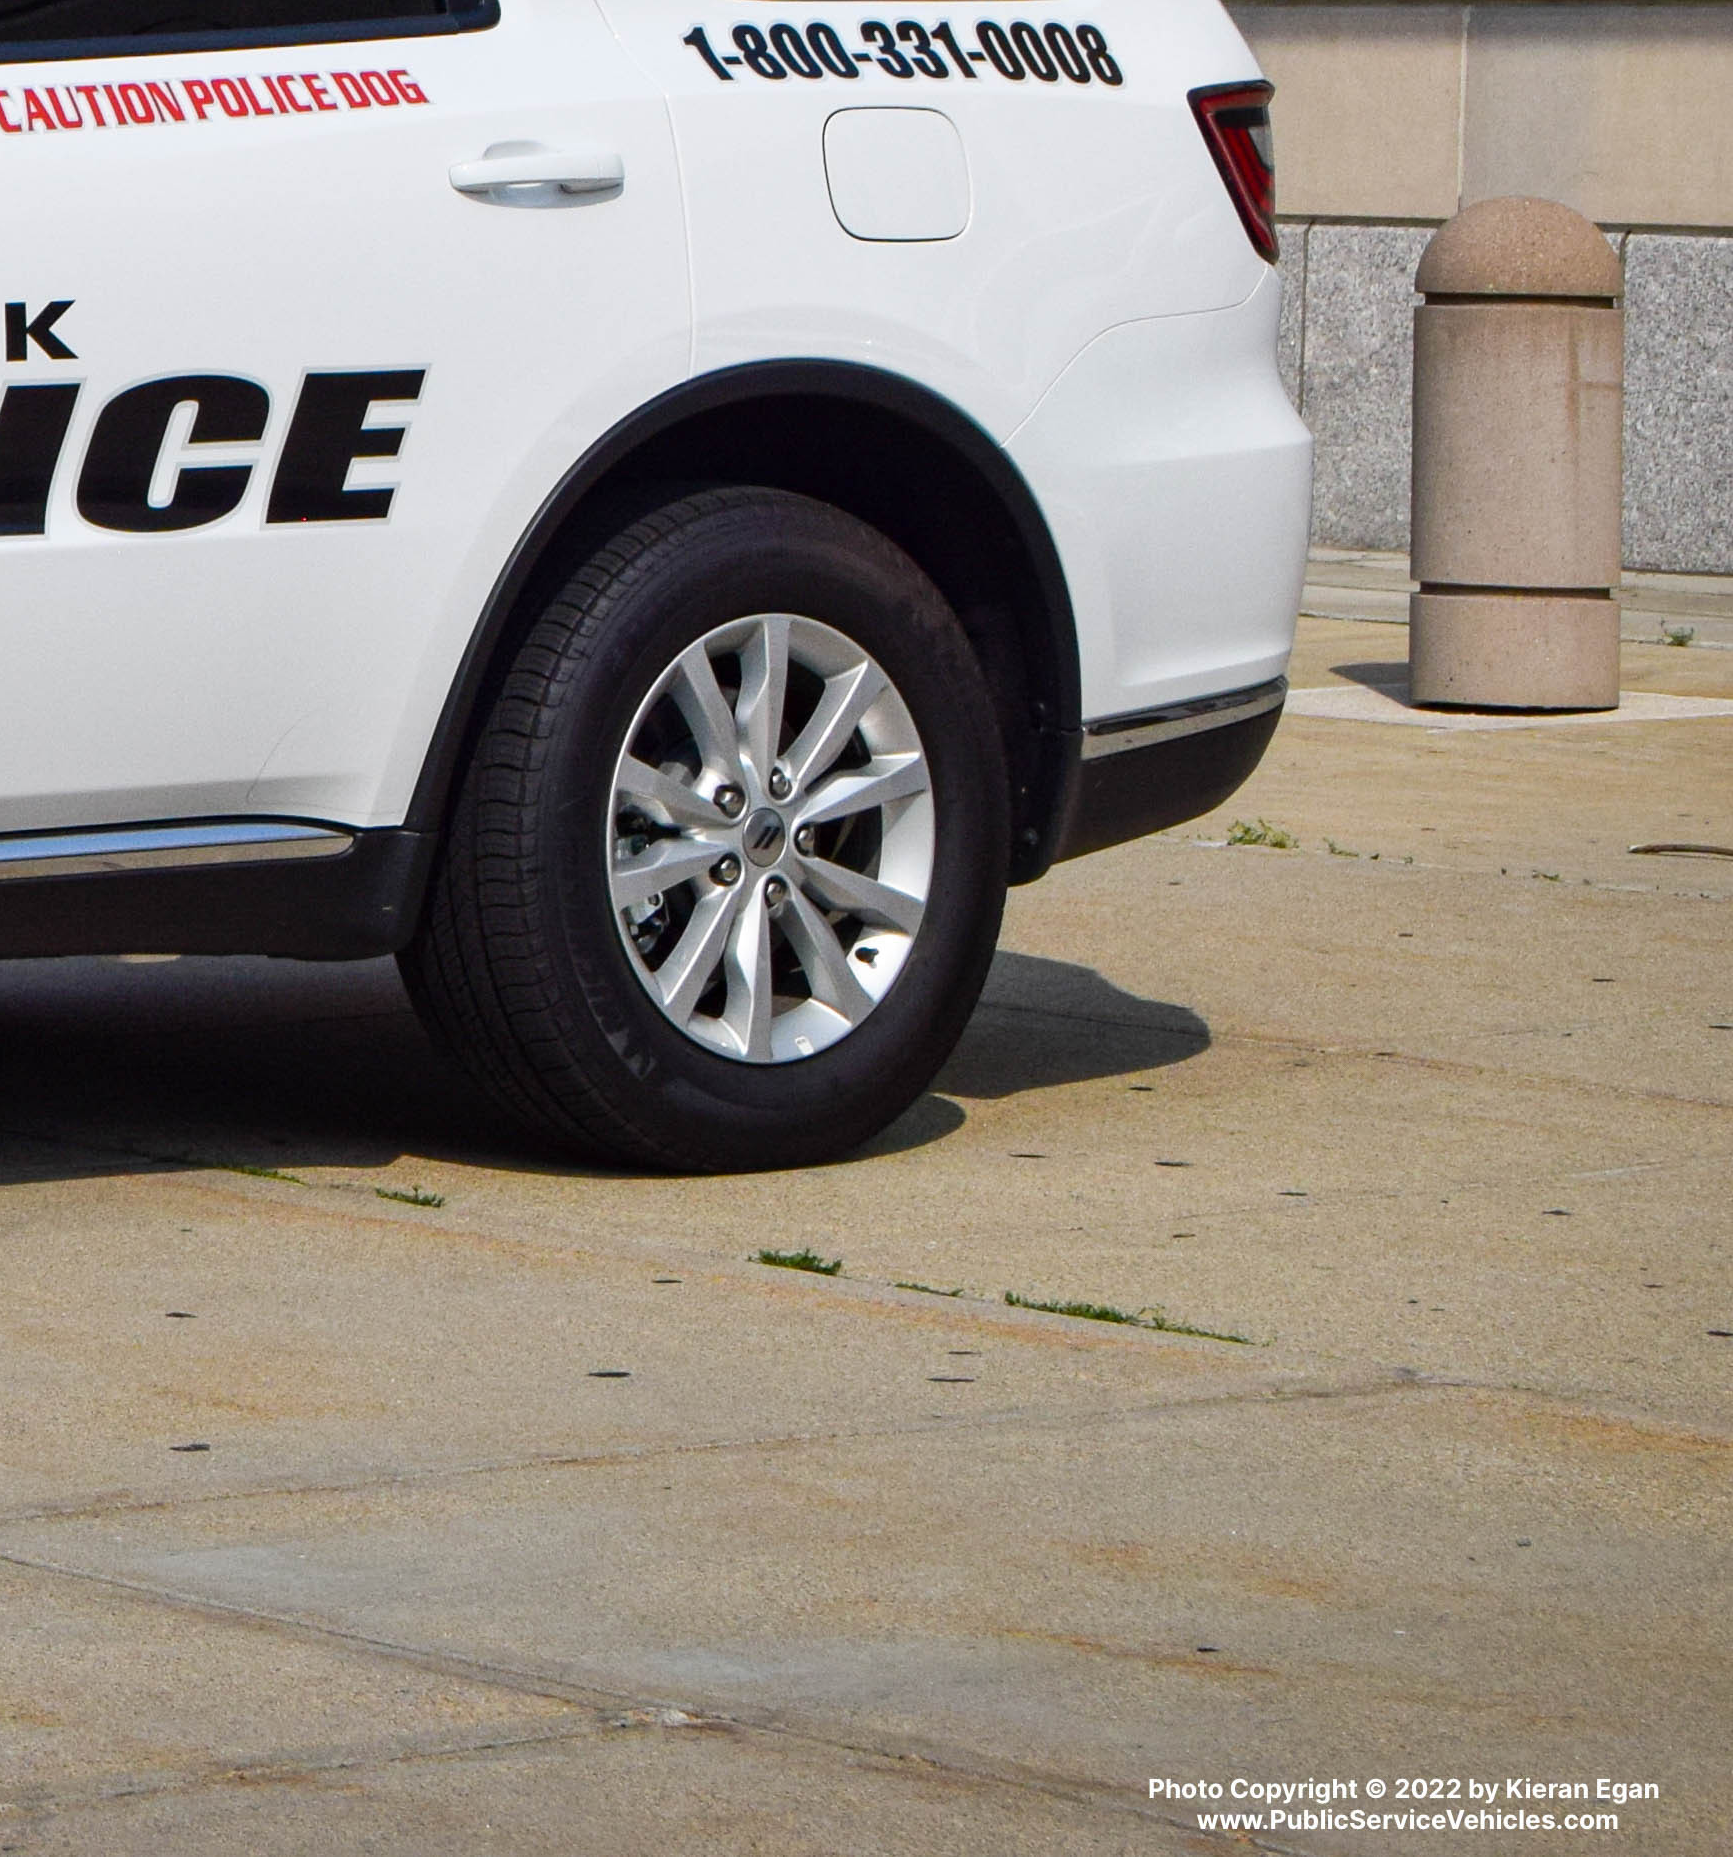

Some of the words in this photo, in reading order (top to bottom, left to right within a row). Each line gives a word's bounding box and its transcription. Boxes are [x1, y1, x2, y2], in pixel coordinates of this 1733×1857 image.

[682, 19, 1125, 87] 1-800-331-0008
[182, 73, 338, 120] POLICE
[335, 69, 431, 110] DOG
